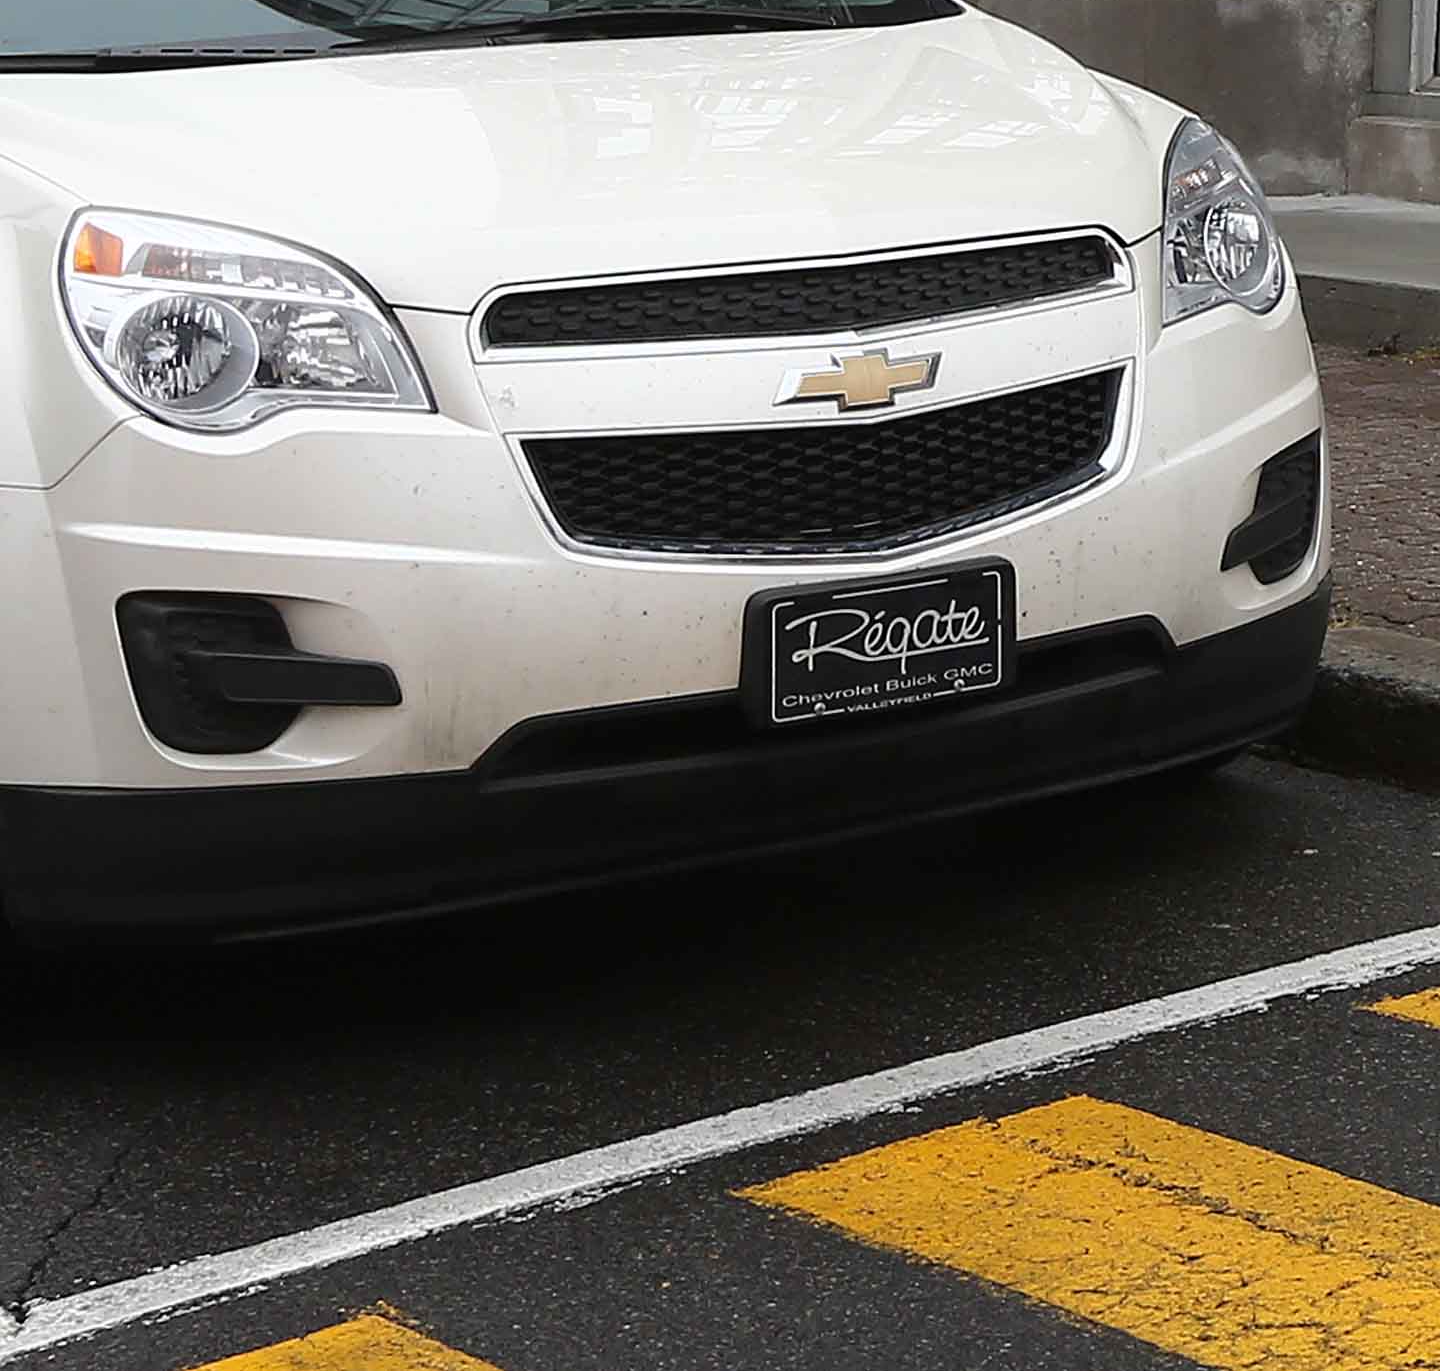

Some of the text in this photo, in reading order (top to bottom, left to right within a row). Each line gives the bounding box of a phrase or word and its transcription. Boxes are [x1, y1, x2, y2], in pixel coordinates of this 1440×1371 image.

[784, 599, 989, 675] Régate
[781, 662, 993, 708] Chevrolet Buick GMC
[846, 692, 932, 713] VALLEYFIELD
